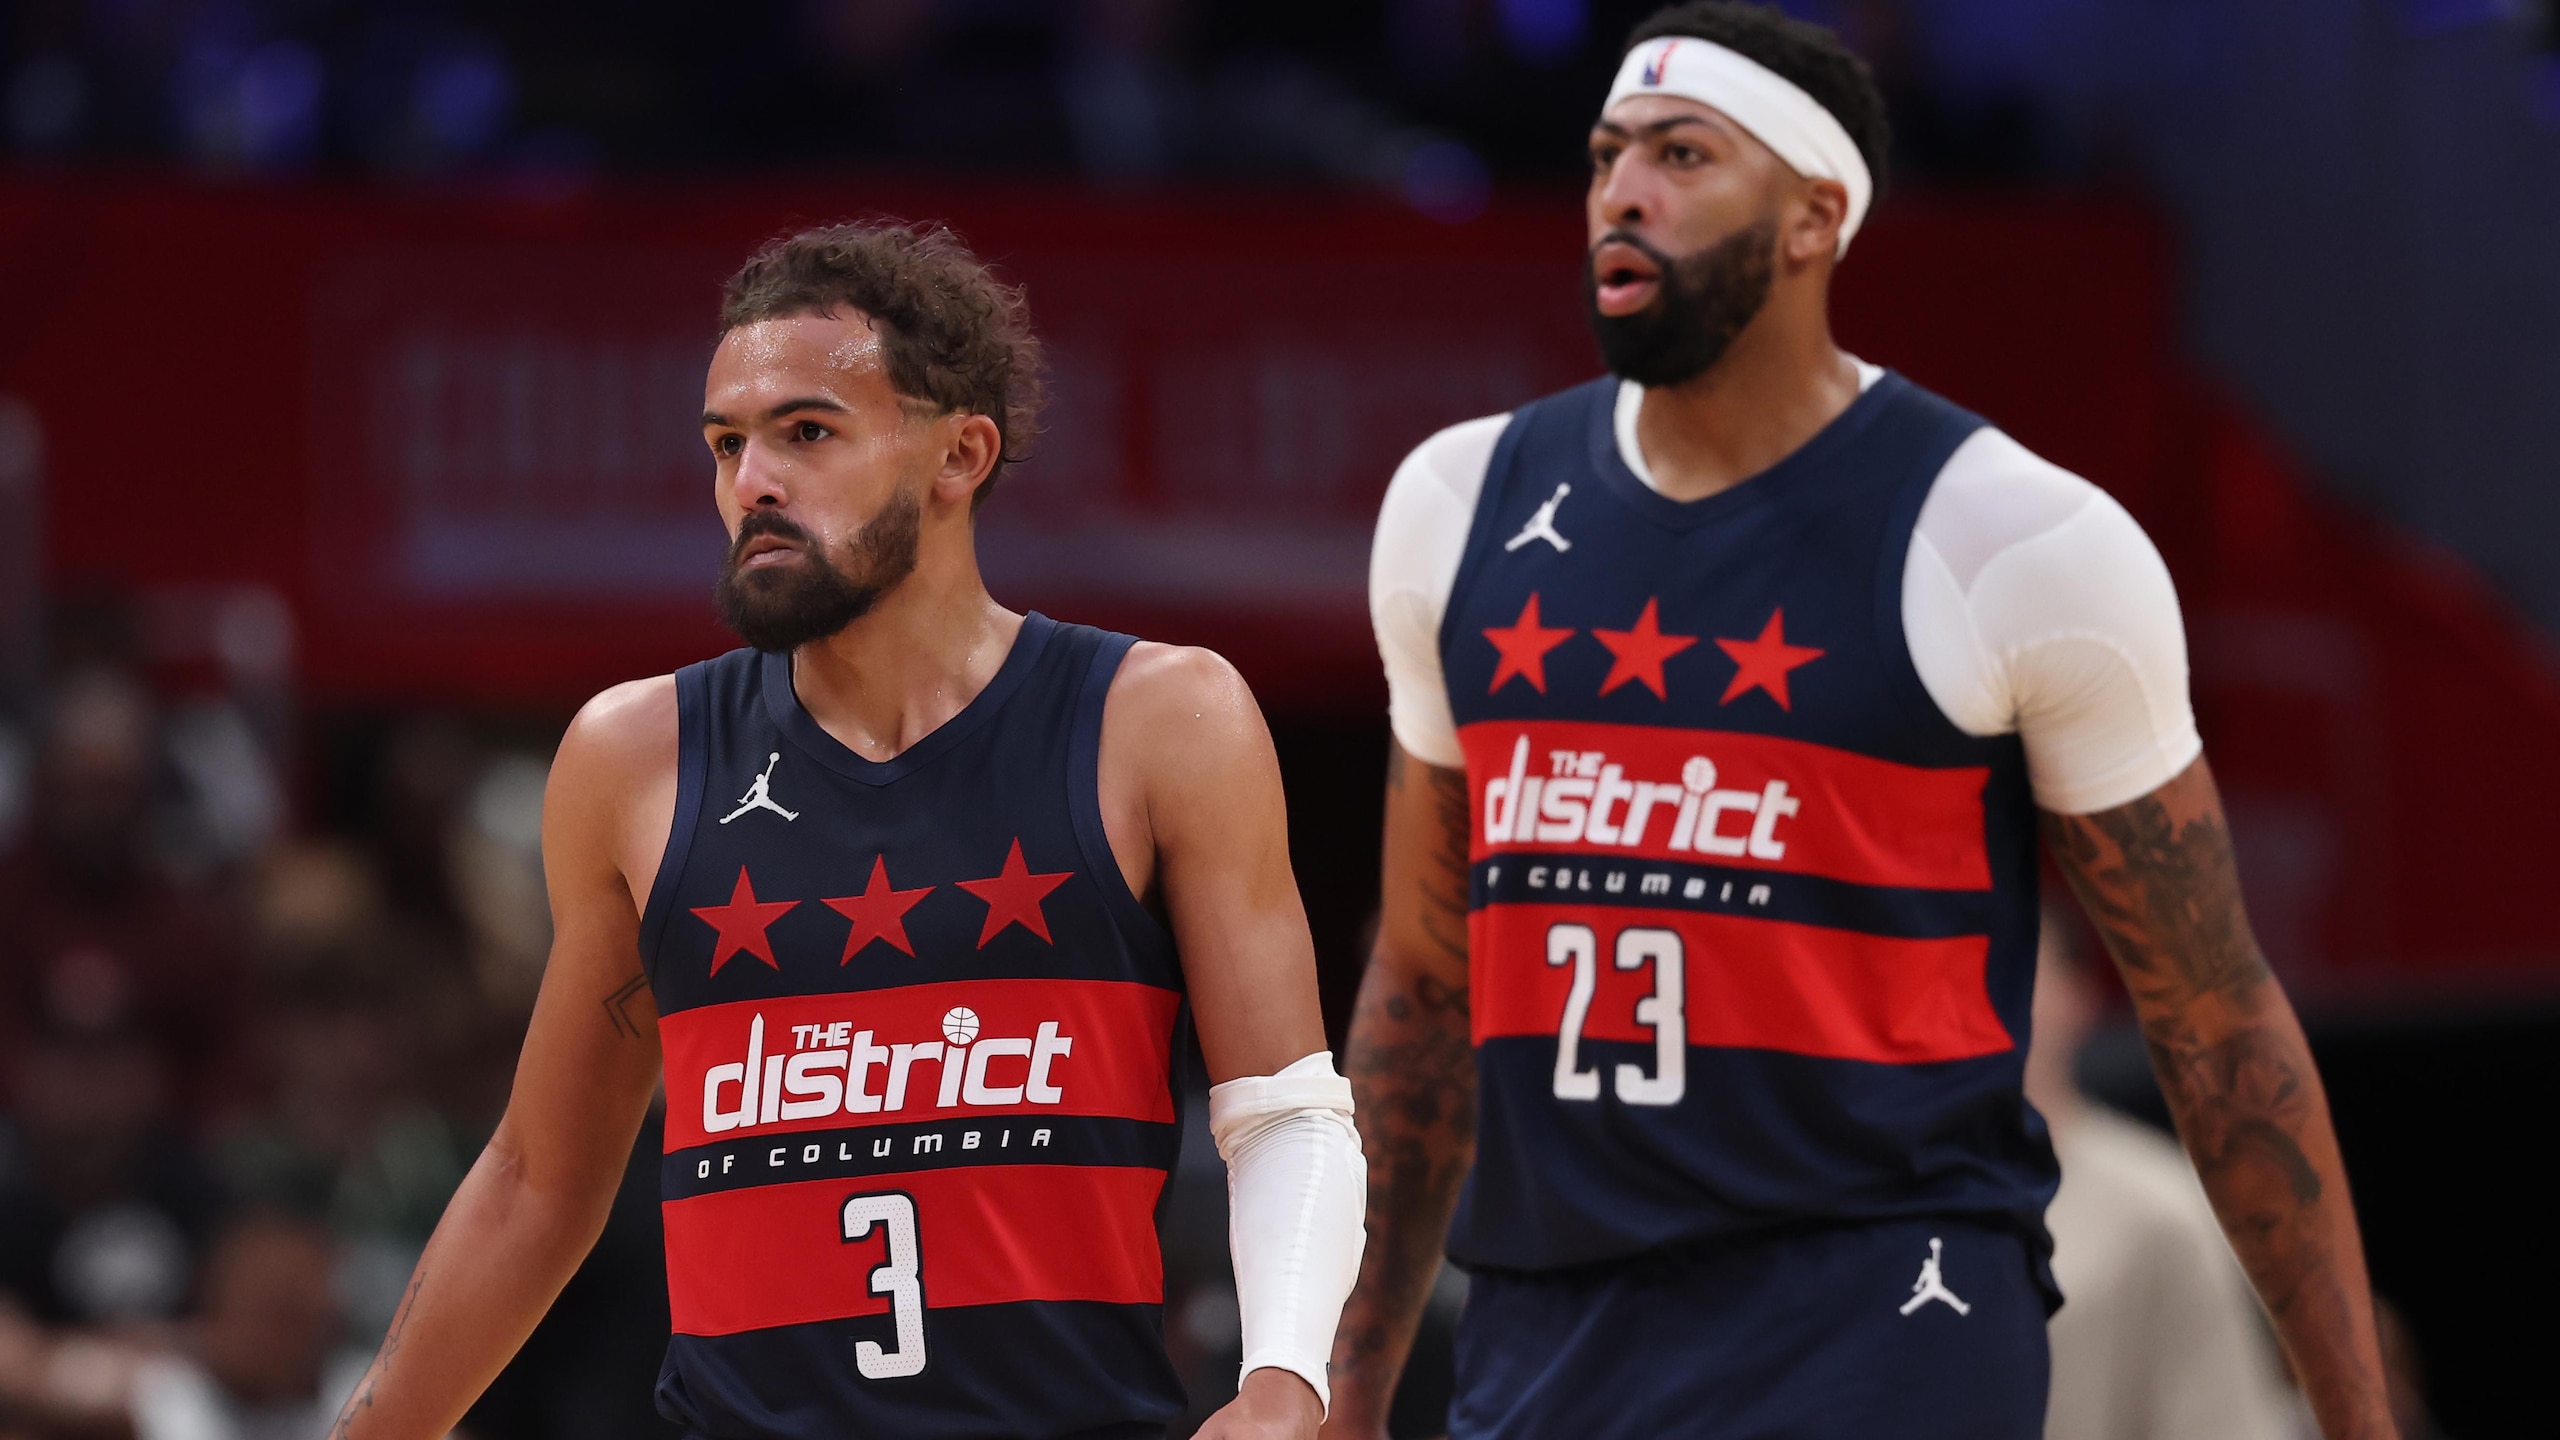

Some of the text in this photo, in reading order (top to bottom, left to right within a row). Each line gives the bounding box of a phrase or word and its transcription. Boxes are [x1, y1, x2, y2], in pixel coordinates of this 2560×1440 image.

[1484, 733, 1800, 861] district
[1549, 749, 1606, 777] THE
[1526, 865, 1772, 906] COLUMBIA
[791, 1020, 853, 1050] THE
[1546, 923, 1687, 1106] 23
[702, 1005, 1073, 1134] district
[697, 1128, 1053, 1180] OF COLUMBIA
[842, 1192, 929, 1381] 3
